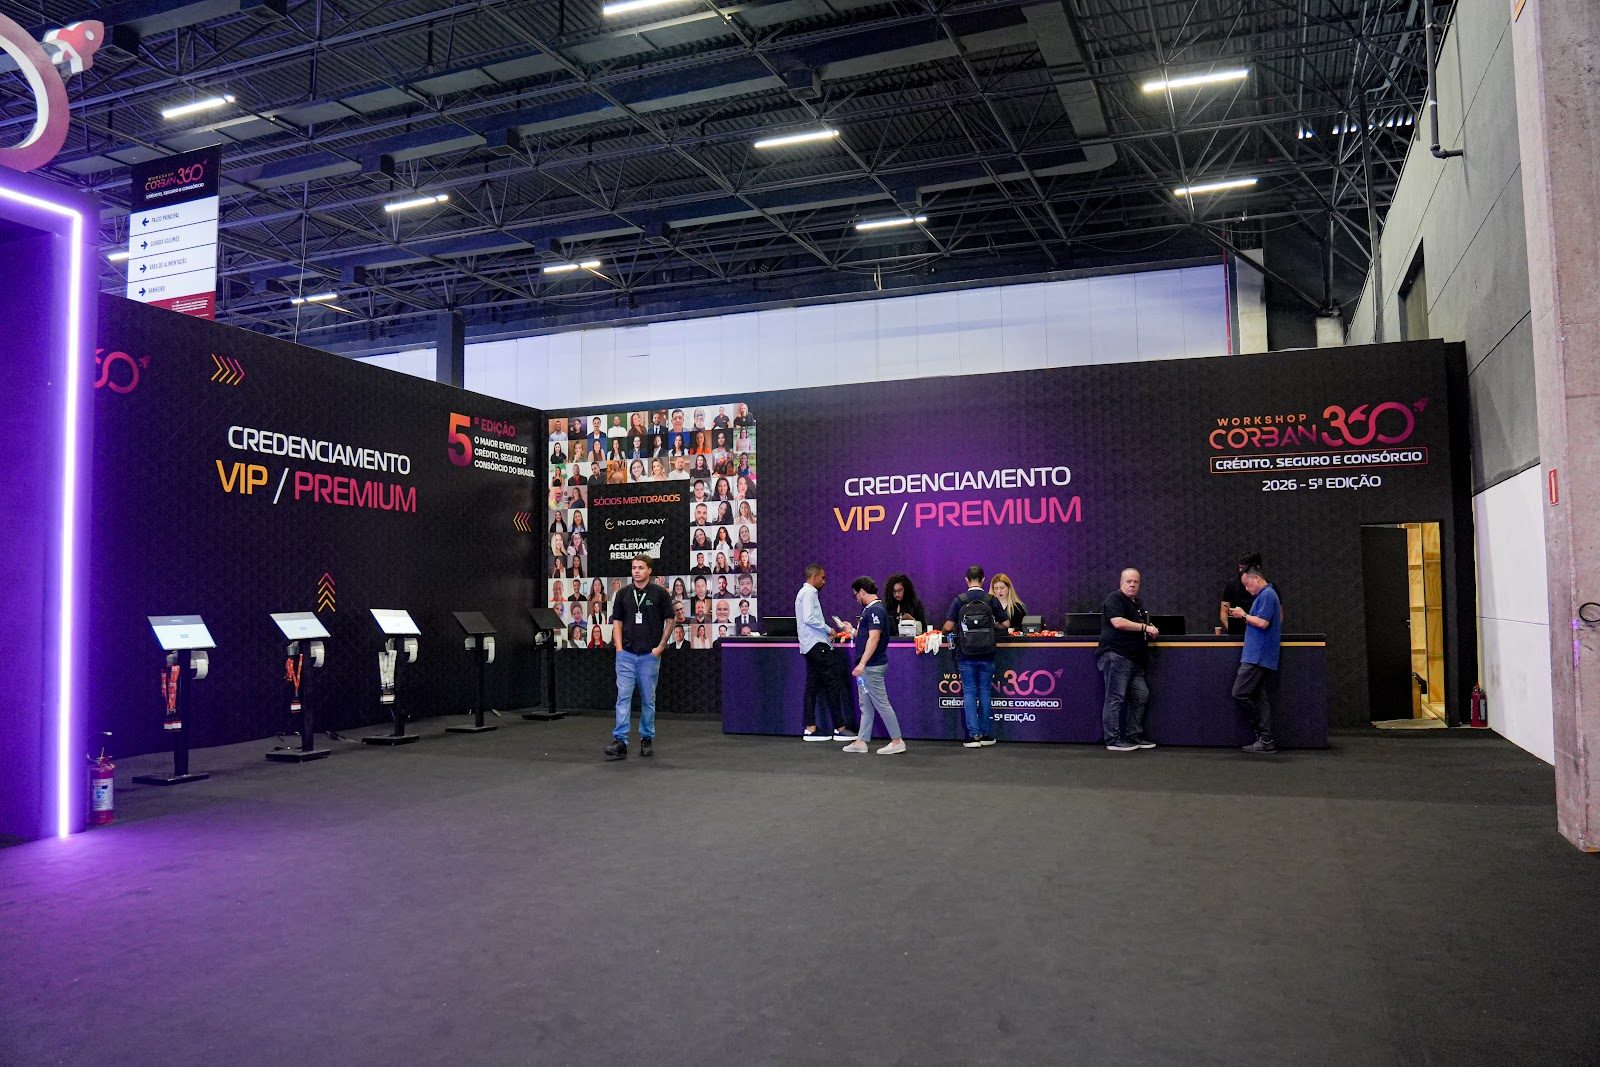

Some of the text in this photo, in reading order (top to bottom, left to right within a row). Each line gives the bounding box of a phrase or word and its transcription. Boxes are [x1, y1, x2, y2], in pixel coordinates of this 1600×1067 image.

[481, 418, 516, 438] EDIÇÃO
[1208, 401, 1415, 450] CORBAN 360
[1217, 413, 1308, 426] WORKSHOP
[228, 425, 410, 474] CREDENCIAMENTO
[474, 436, 528, 454] O MAIOR EVENTO DE
[474, 447, 500, 461] CRÉDITO,
[500, 454, 522, 464] SEGURO
[1215, 450, 1422, 470] CRÉDITO, SEGURO E CONSÓRCIO
[474, 460, 508, 472] CONSÓRCIO
[517, 468, 536, 478] BRASIL
[216, 460, 268, 494] VIP
[294, 470, 417, 512] PREMIUM
[844, 466, 1072, 496] CREDENCIAMENTO
[1262, 479, 1297, 492] 2026
[1326, 474, 1382, 490] EDIÇÃO
[623, 494, 680, 505] MENTORADOS
[626, 518, 666, 526] COMPANY
[833, 504, 886, 532] VIP
[916, 496, 1082, 528] PREMIUM
[609, 542, 661, 550] ACELERANDO
[1003, 670, 1056, 696] 360
[1004, 712, 1036, 722] EDIÇÃO
